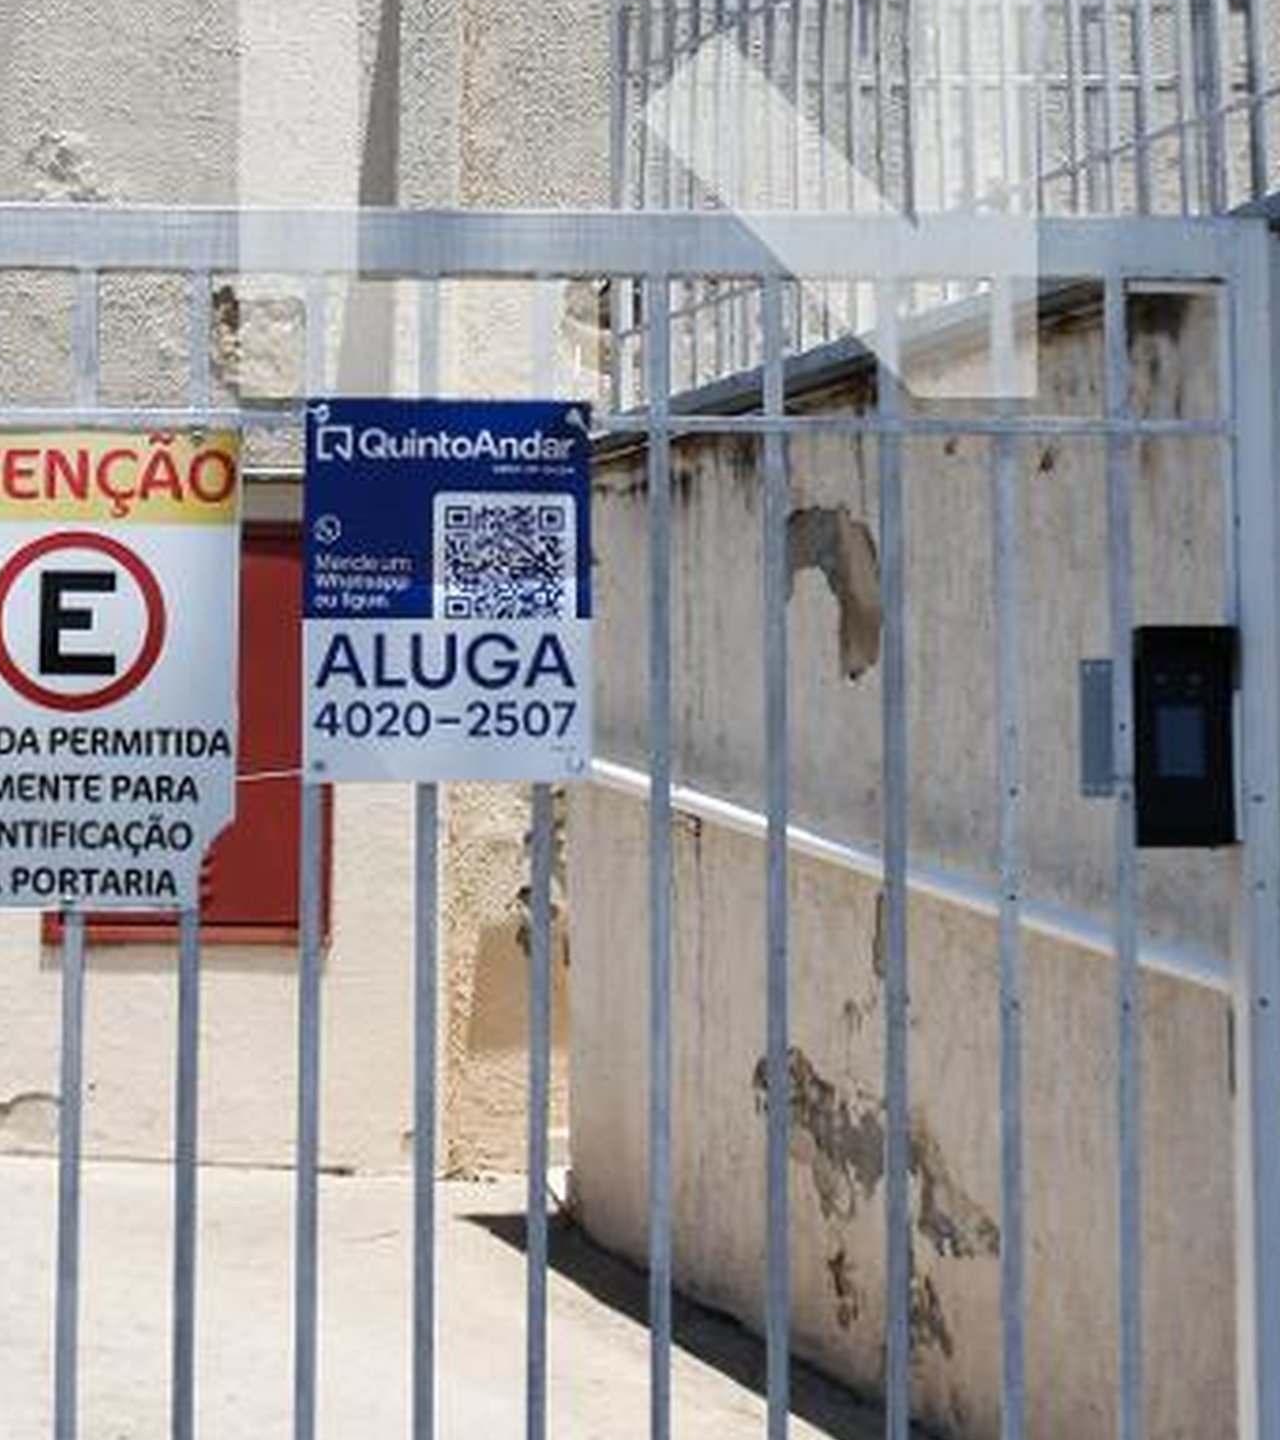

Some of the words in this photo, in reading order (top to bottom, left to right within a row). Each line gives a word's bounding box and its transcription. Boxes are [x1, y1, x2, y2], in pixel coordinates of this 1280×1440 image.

[359, 427, 575, 460] QuintoAndar
[37, 570, 116, 675] E
[315, 632, 576, 690] ALUGA
[313, 700, 577, 738] 4020-2507
[48, 727, 232, 759] PERMITIDA
[110, 775, 199, 803] PARA
[11, 869, 178, 897] PORTARIA
